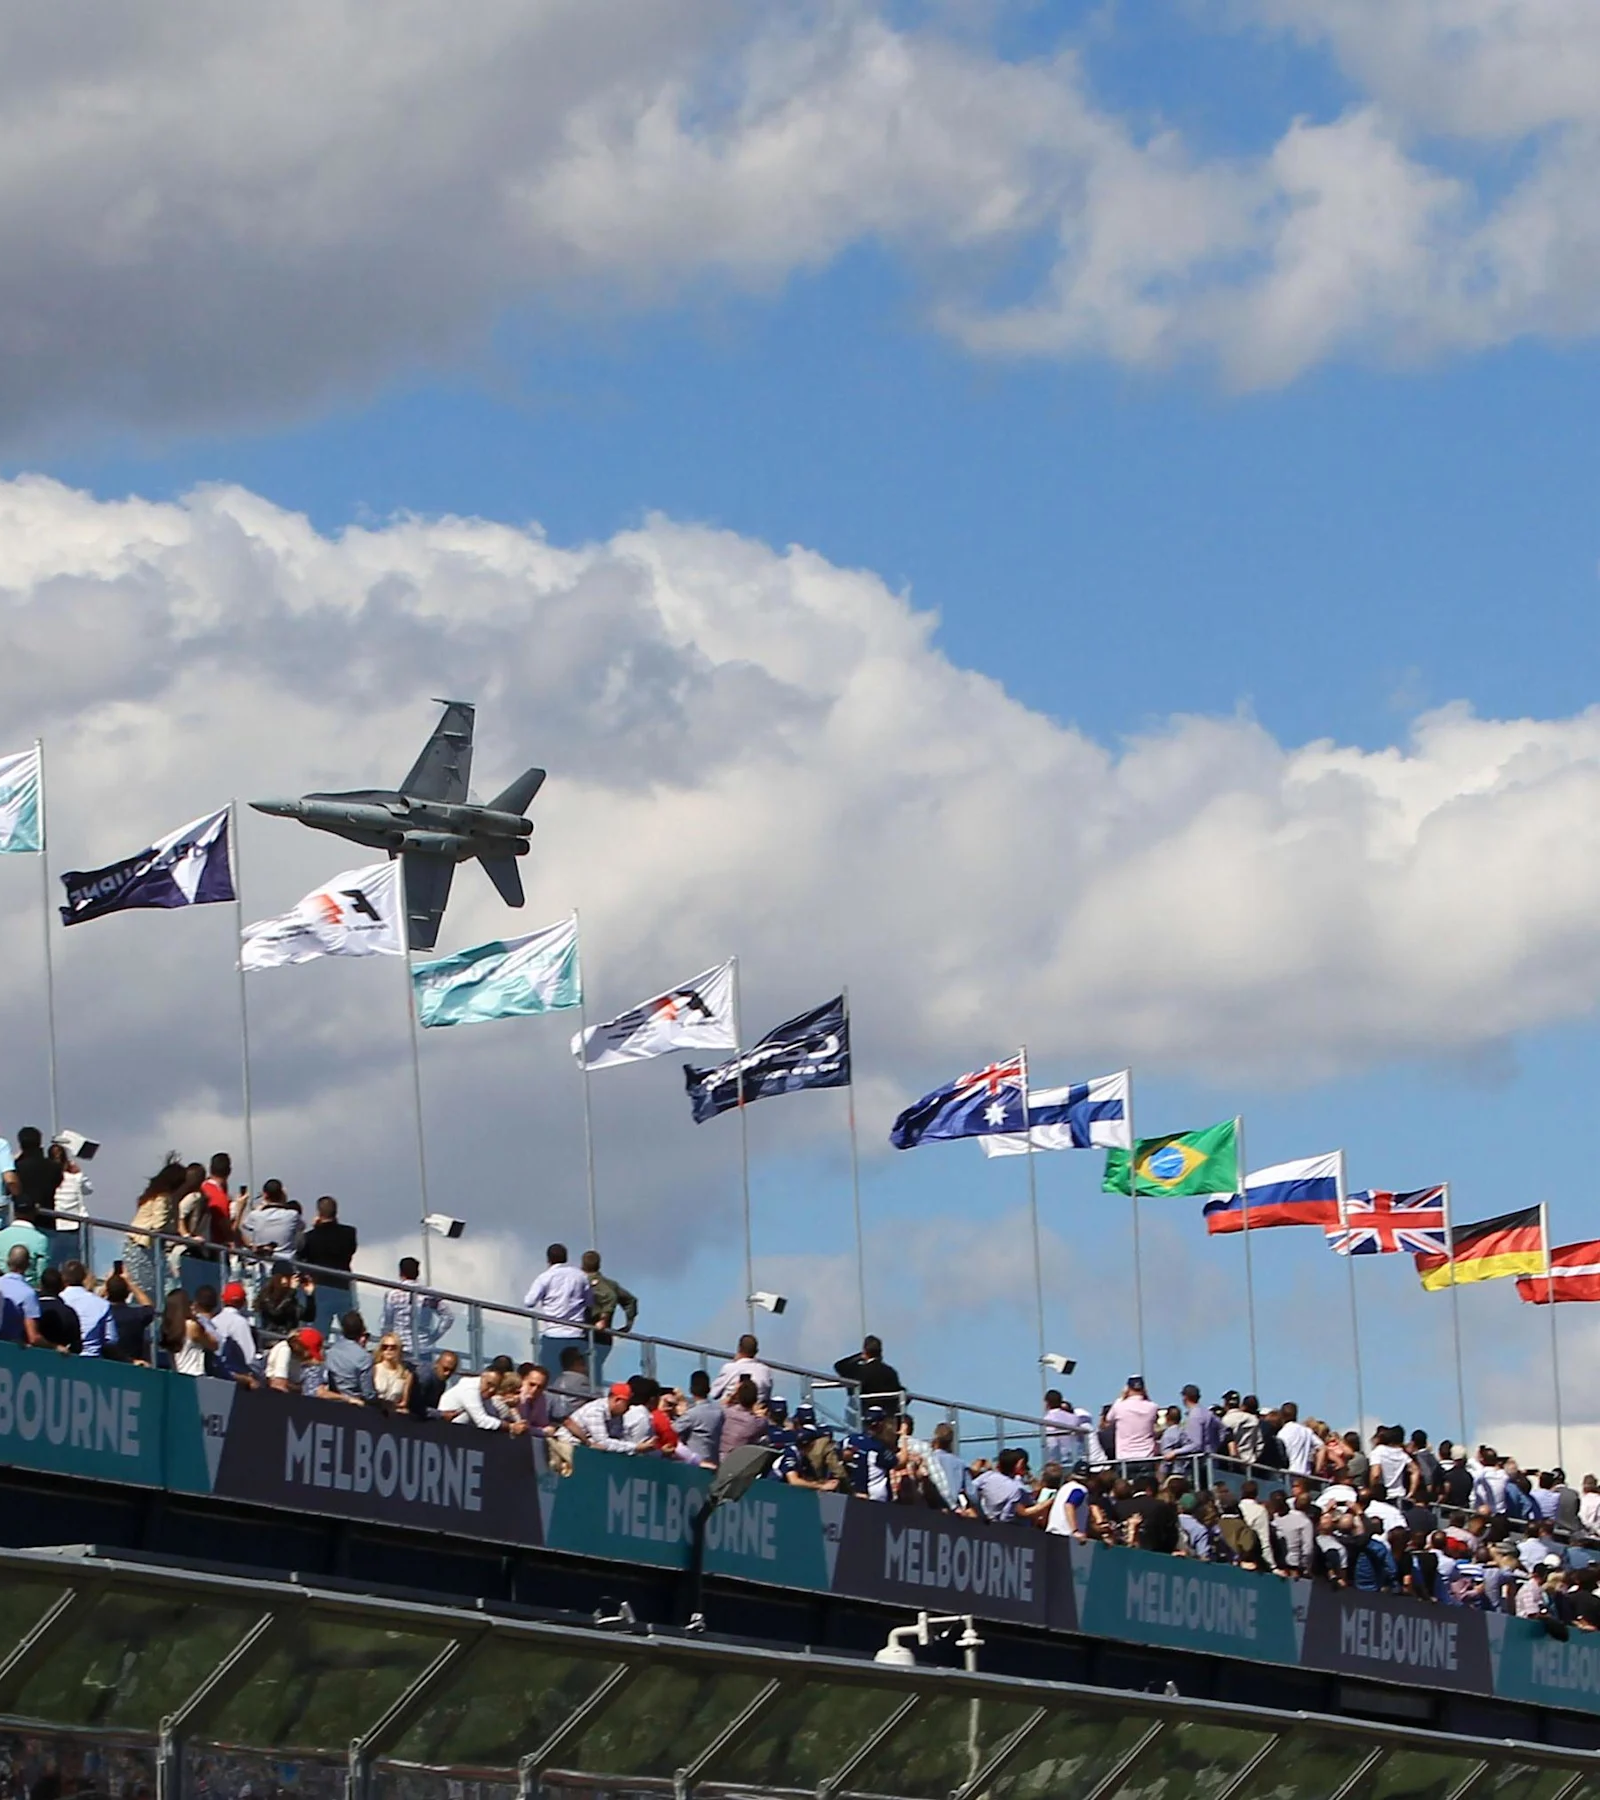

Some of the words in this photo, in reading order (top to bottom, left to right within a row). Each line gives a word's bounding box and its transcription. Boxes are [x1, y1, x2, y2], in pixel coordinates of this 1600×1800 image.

[285, 1417, 485, 1512] MELBOURNE
[884, 1523, 1034, 1602] MELBOURNE
[1126, 1570, 1260, 1640] MELBOURNE
[1340, 1604, 1458, 1671] MELBOURNE
